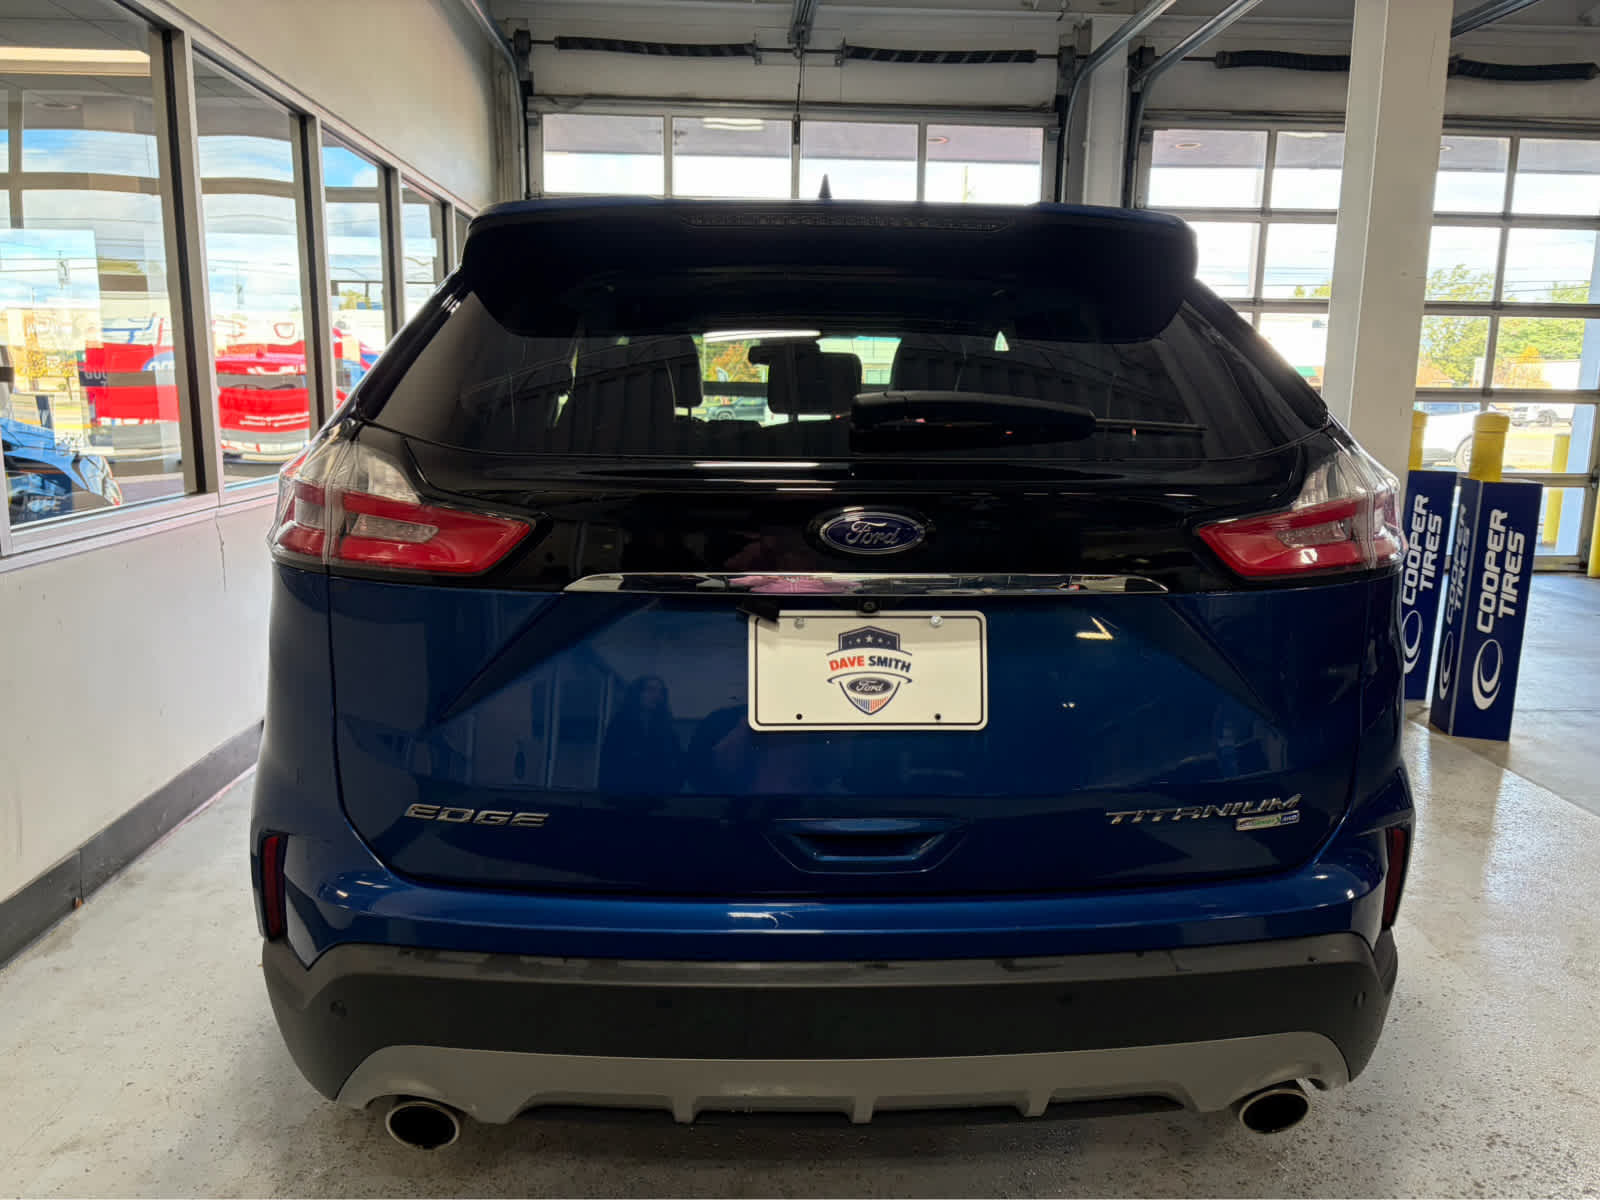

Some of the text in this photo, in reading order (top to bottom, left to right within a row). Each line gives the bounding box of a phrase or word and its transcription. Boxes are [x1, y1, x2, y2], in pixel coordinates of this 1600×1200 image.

[844, 520, 901, 545] Ford
[1402, 494, 1429, 606] COOPER
[1419, 512, 1442, 591] TIRES
[1476, 508, 1508, 634] COOPER
[1498, 531, 1526, 618] TIRES
[829, 655, 911, 672] DAVE SMITH
[855, 679, 885, 692] Ford
[404, 803, 550, 827] EDGE
[1106, 793, 1302, 825] TITANIUM
